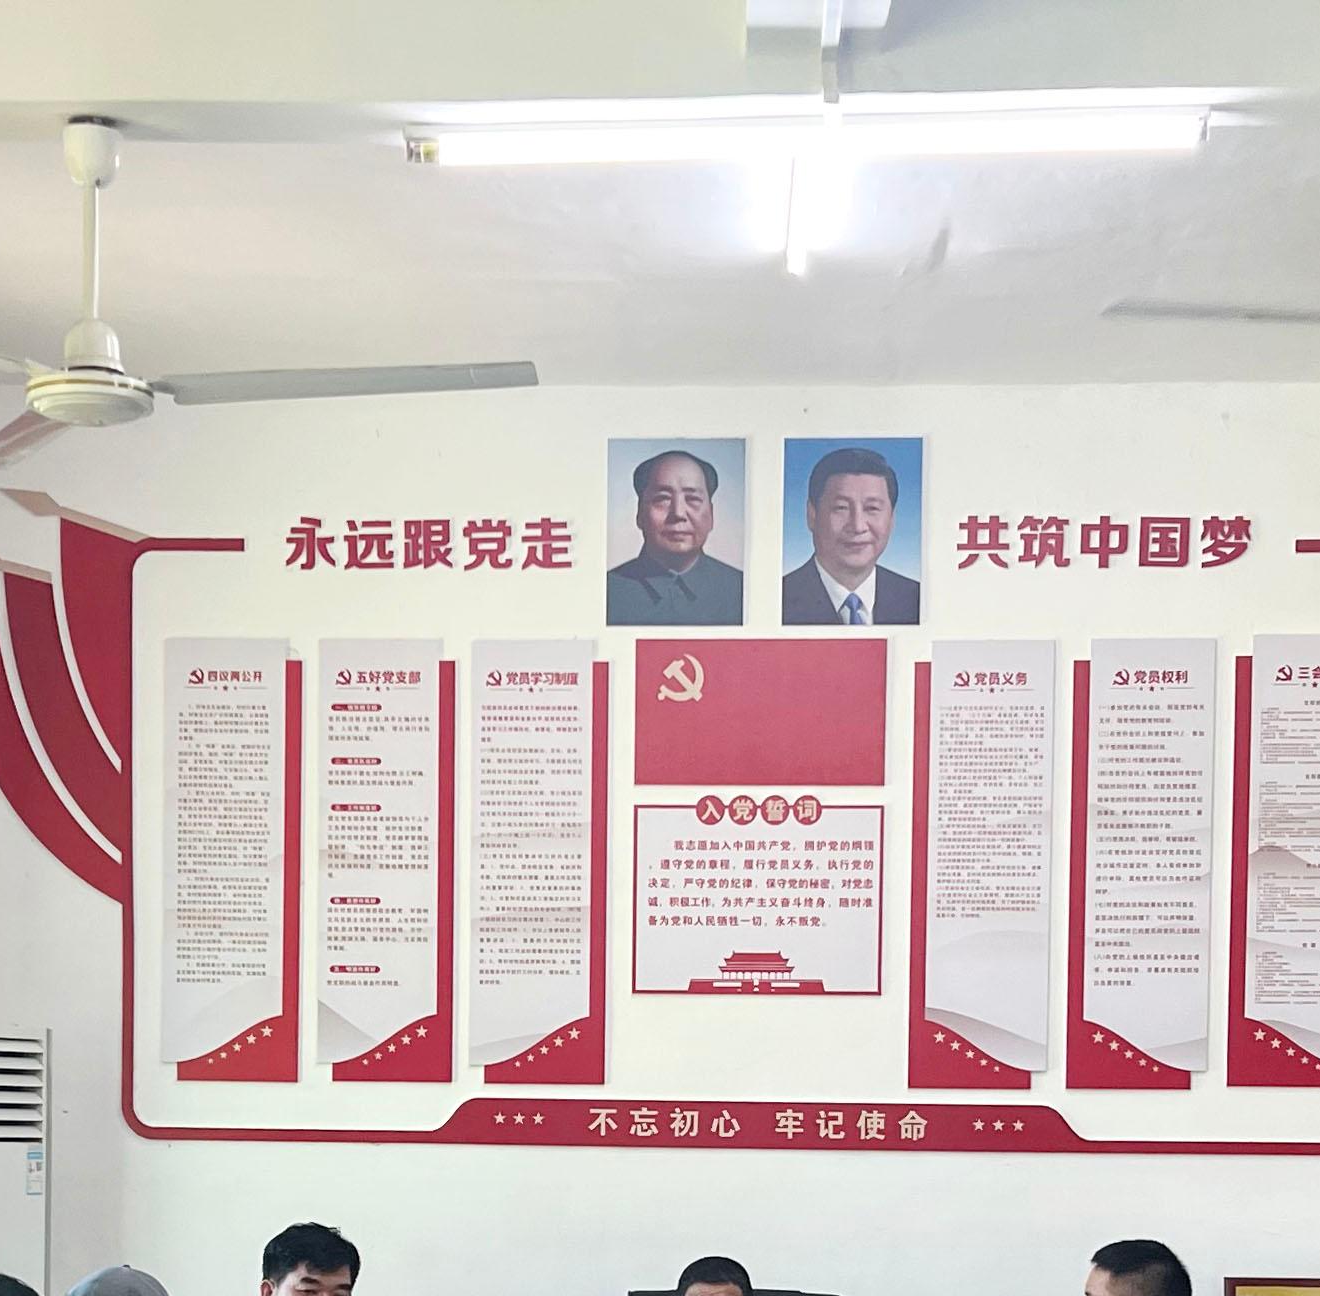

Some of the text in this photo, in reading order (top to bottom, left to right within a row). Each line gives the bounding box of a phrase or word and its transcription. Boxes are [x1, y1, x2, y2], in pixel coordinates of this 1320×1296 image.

[284, 516, 573, 570] 永远跟党走
[955, 514, 1254, 568] 共筑中国梦
[207, 670, 263, 683] 四议两公开
[356, 670, 422, 685] 五好党支部
[506, 671, 579, 686] 党员学习制度
[974, 672, 1028, 686] 党员义务
[1133, 668, 1189, 686] 党员权利
[699, 799, 818, 822] 入党誓词
[587, 1107, 929, 1140] 不忘初心 牢记使命
